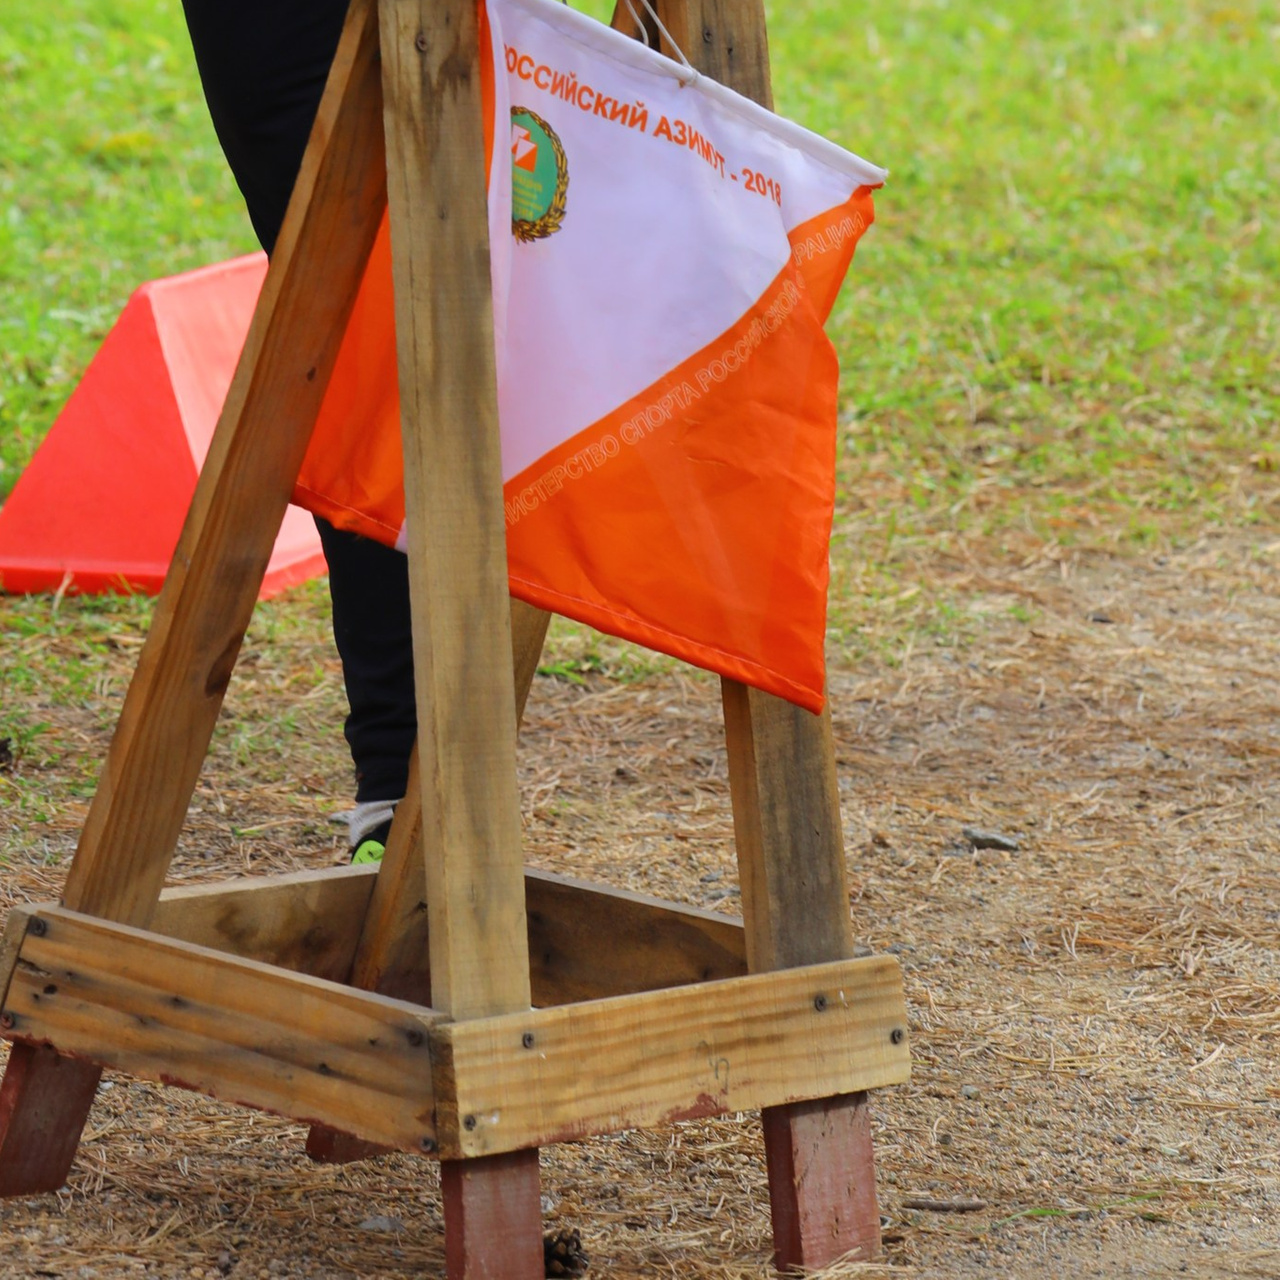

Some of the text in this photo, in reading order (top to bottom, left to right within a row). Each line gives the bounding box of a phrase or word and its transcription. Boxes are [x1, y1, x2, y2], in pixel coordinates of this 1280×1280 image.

[504, 44, 648, 132] ОССИЙСКИЙ
[653, 115, 725, 180] АЗИМУТ
[742, 167, 782, 208] 2018
[620, 381, 700, 446] СПОРТА
